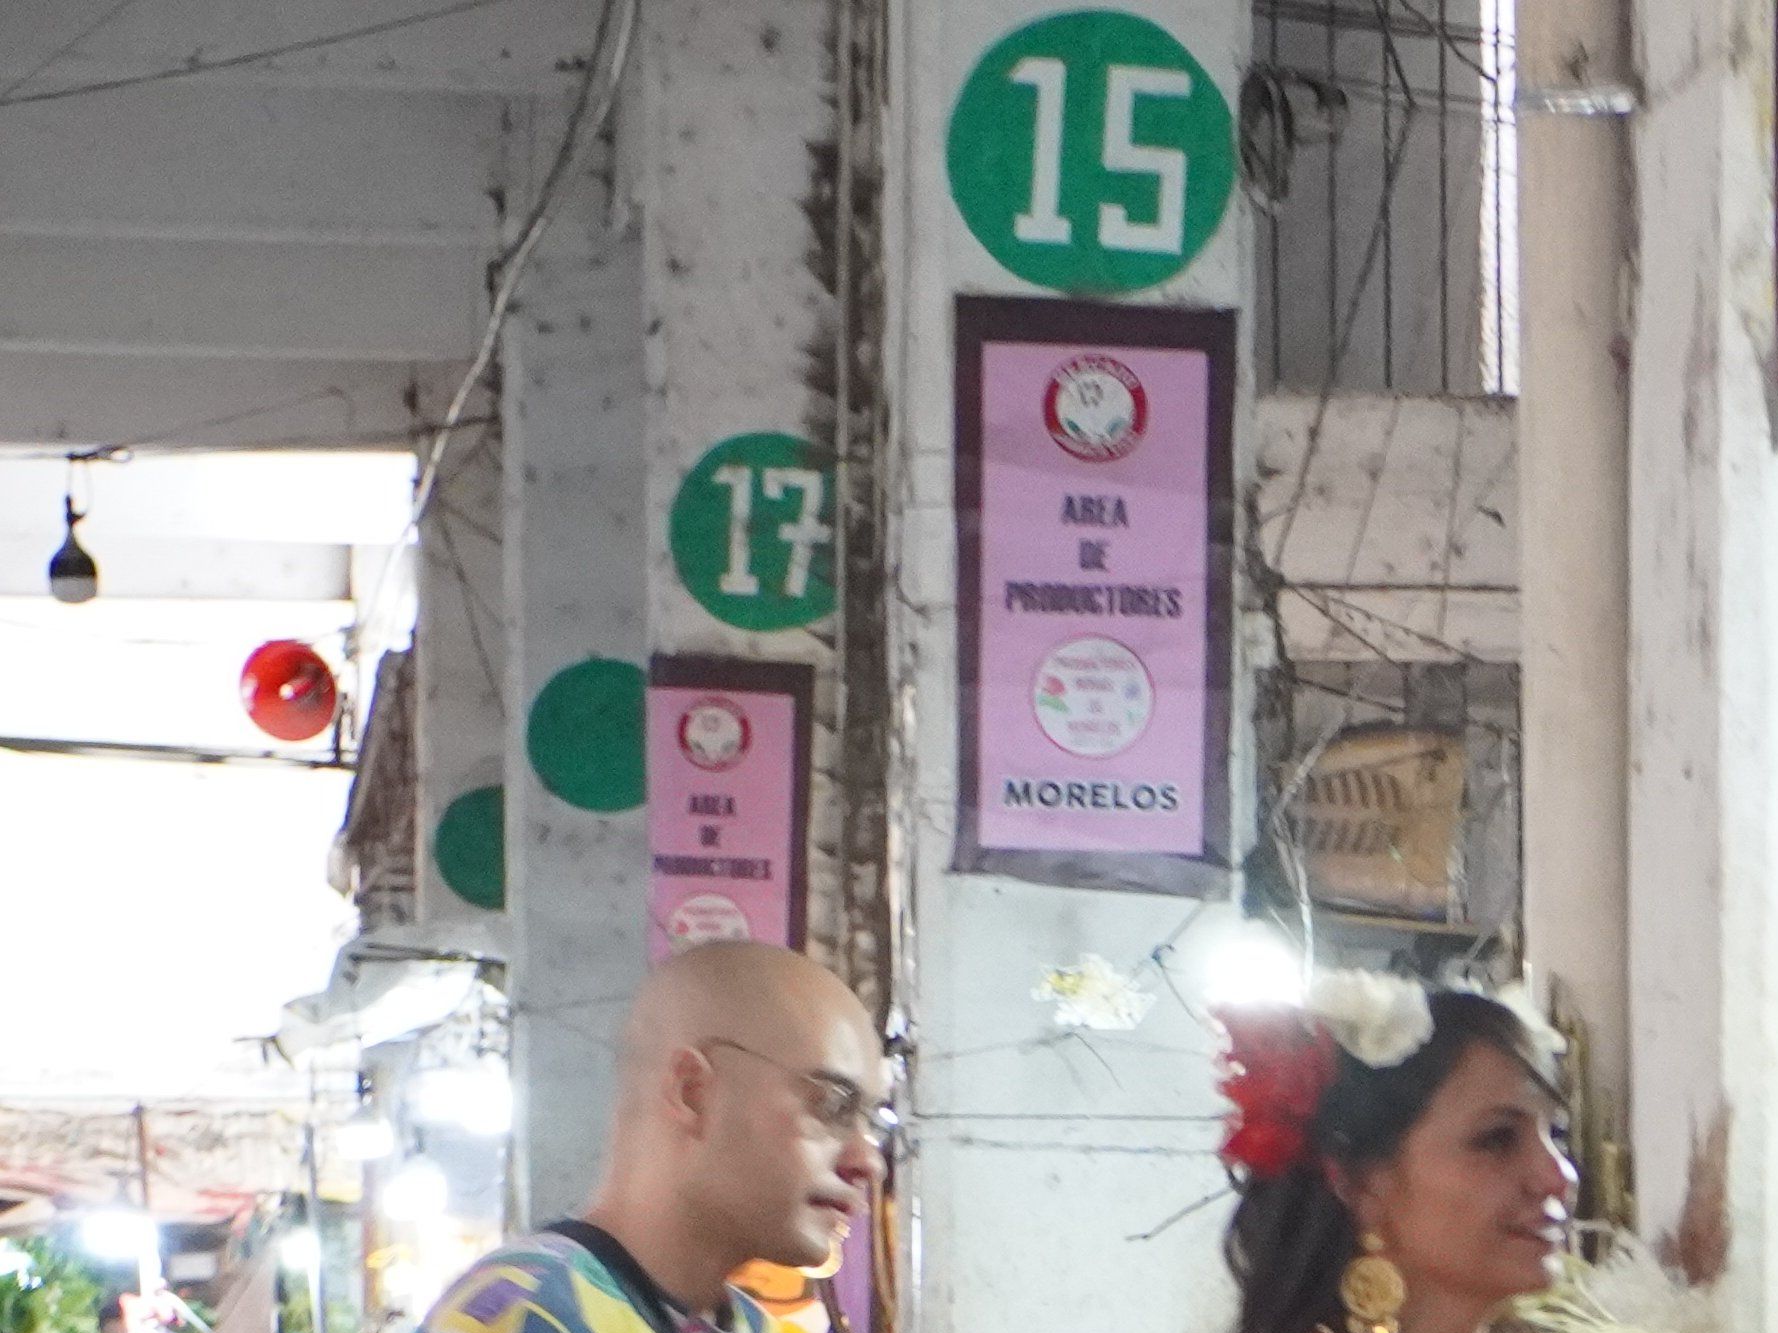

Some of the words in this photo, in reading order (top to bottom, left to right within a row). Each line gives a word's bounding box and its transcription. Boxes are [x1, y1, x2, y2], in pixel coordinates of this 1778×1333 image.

[1010, 56, 1192, 256] 15
[1060, 495, 1129, 528] AREA
[712, 465, 832, 598] 17
[1079, 538, 1109, 571] DE
[1005, 581, 1184, 617] PRODUCTORES
[1004, 780, 1180, 811] MORELOS
